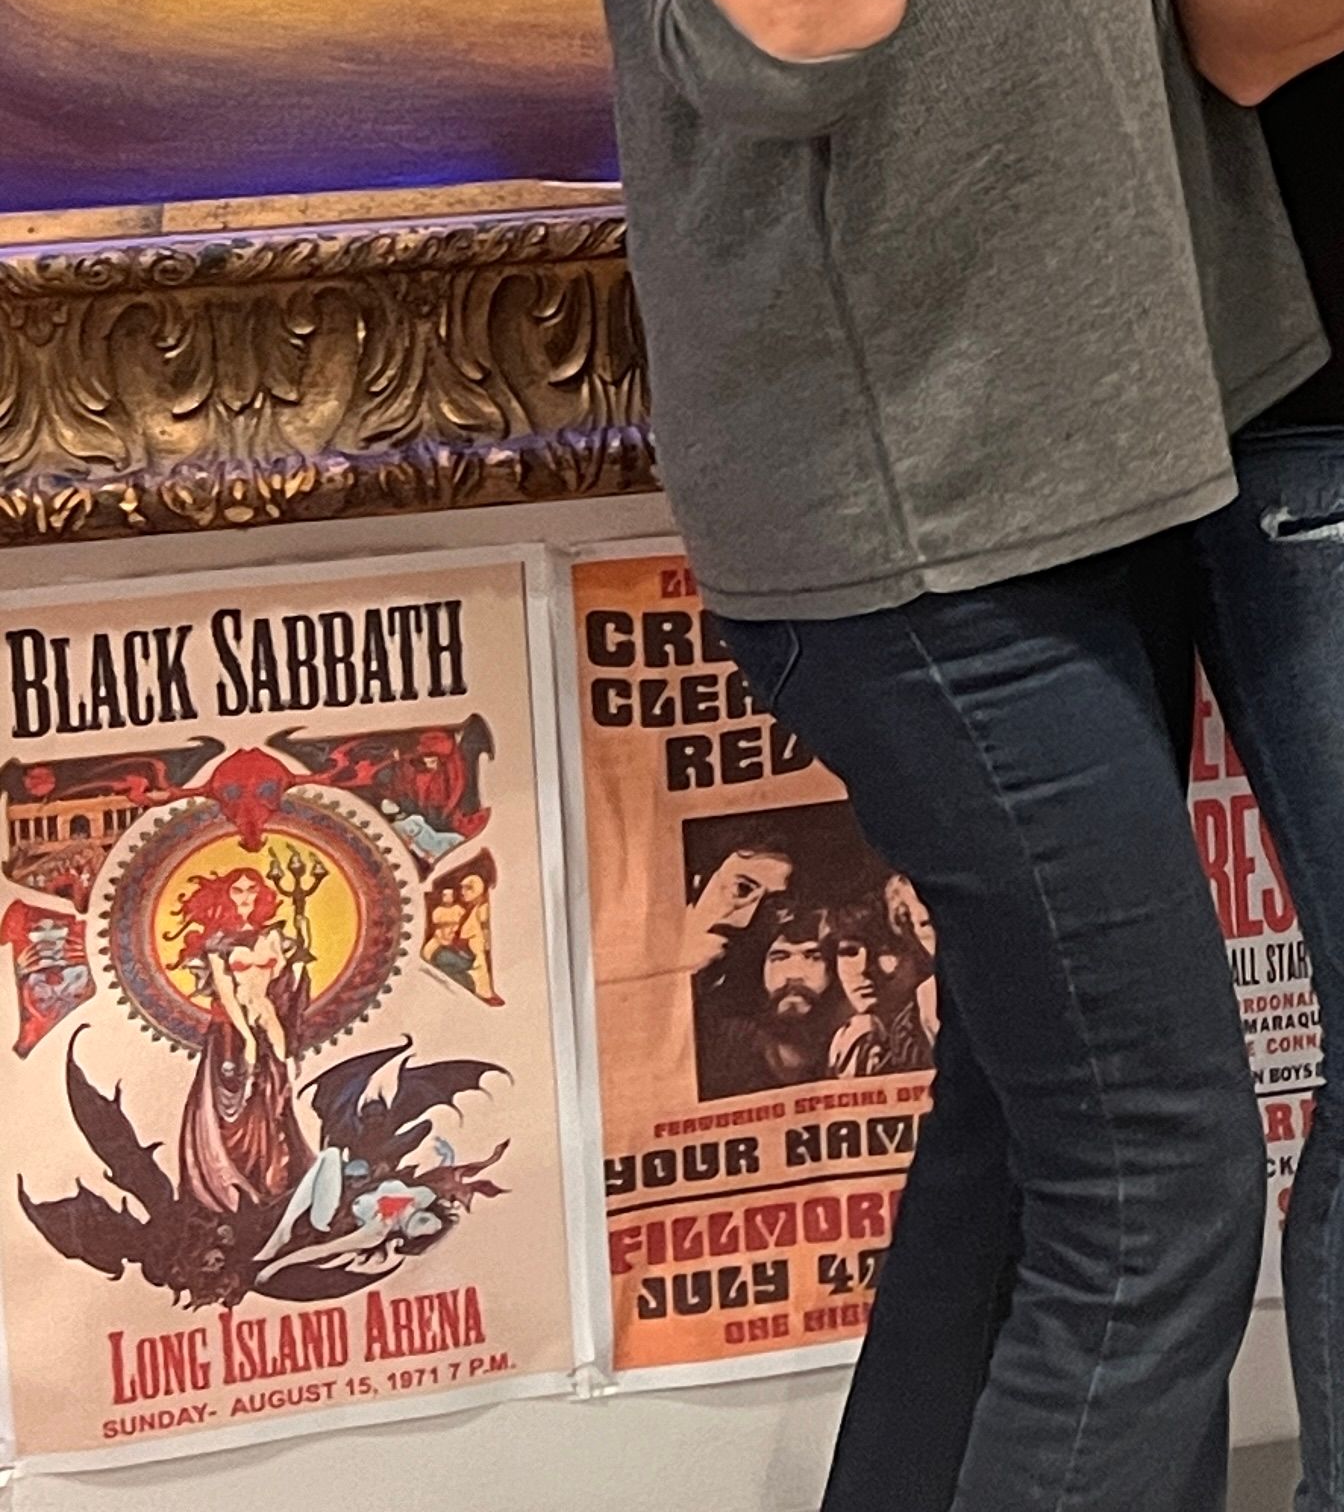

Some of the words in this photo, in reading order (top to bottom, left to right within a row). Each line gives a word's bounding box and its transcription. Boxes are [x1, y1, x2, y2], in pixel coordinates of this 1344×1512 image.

[5, 624, 199, 739] BLACK
[211, 599, 468, 717] SABBATH
[1269, 1062, 1313, 1084] BOYS
[604, 1136, 760, 1198] YOUR
[637, 1257, 790, 1320] JULY
[107, 1325, 212, 1406] LONG
[218, 1305, 349, 1387] ISLAND
[363, 1285, 486, 1364] ARENA
[724, 1313, 790, 1344] ONE
[102, 1402, 218, 1440] SUNDAY-
[230, 1380, 338, 1418] AUGUST
[345, 1375, 379, 1401] 15,
[386, 1365, 440, 1393] 1971
[449, 1362, 460, 1380] 7
[468, 1351, 517, 1378] P.M.
